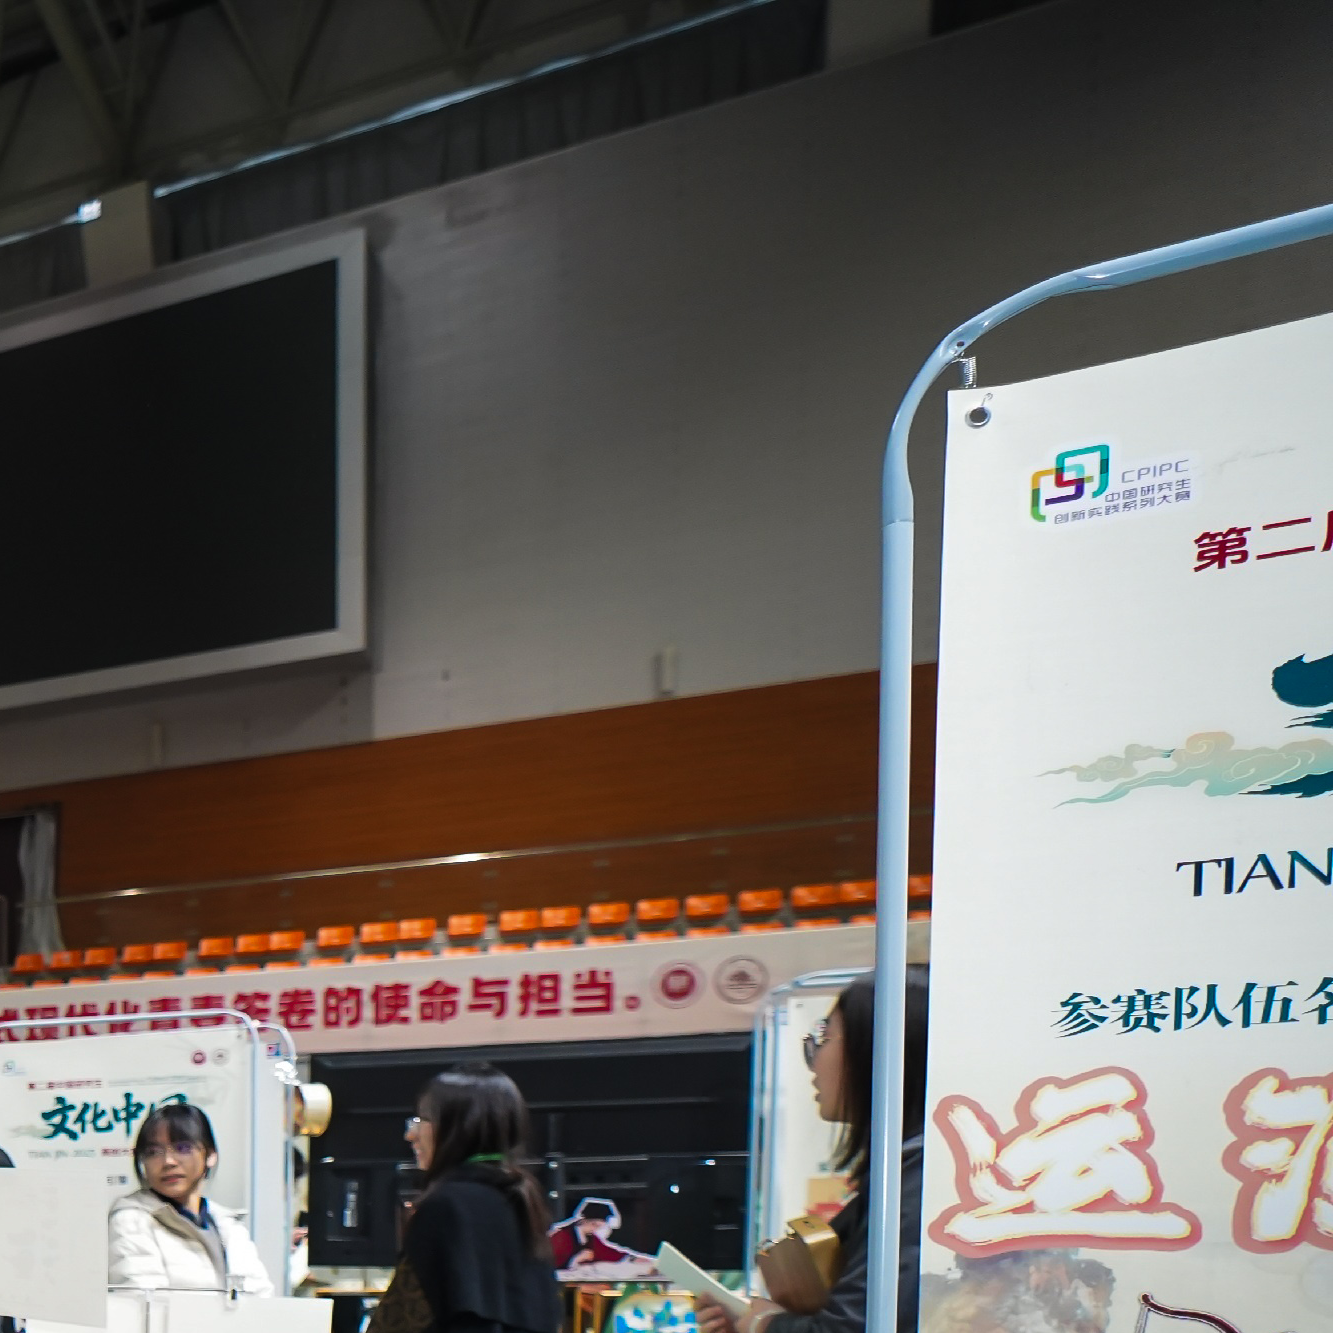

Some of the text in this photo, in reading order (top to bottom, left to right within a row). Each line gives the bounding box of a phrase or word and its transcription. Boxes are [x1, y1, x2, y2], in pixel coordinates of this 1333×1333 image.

[1122, 460, 1190, 483] CPIPC
[1054, 490, 1191, 524] 创新实践系列大赛
[1105, 479, 1191, 503] 中国研究生
[1193, 510, 1333, 573] 第二
[41, 1092, 187, 1141] 文化中
